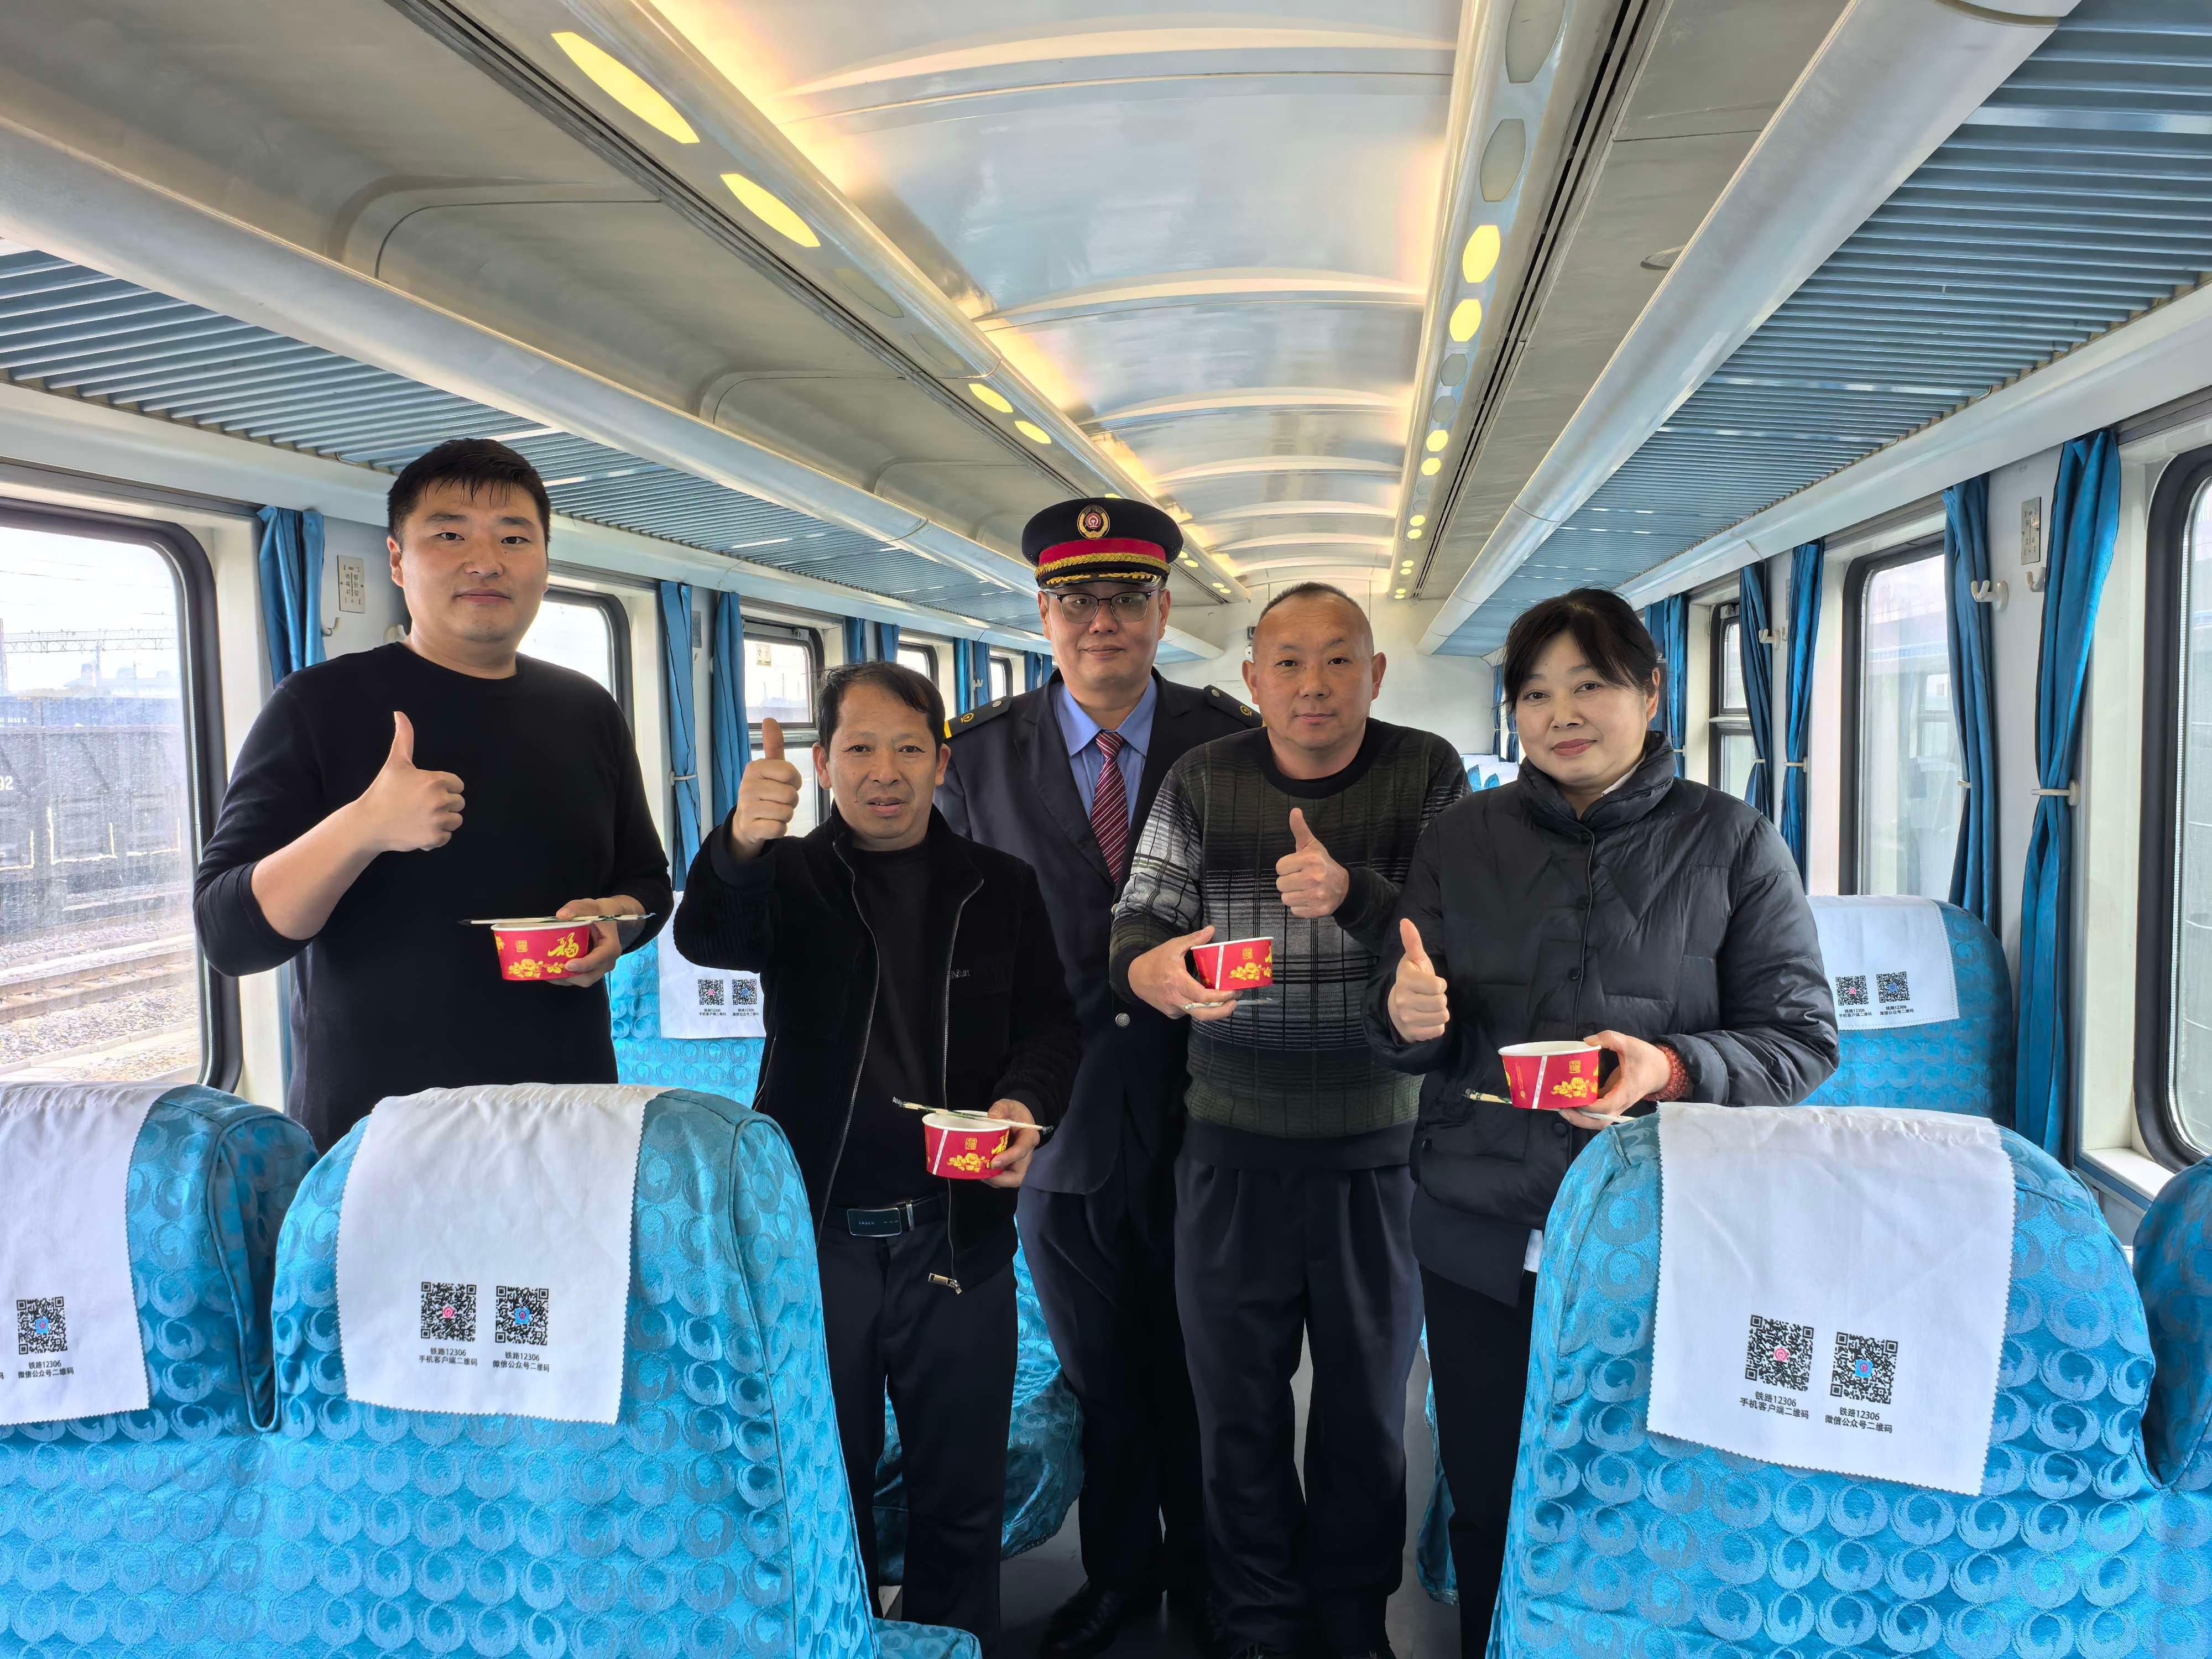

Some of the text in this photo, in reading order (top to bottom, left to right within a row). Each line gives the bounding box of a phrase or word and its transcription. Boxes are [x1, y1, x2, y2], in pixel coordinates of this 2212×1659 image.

[430, 1347, 467, 1357] 铁路12306
[505, 1351, 540, 1361] 铁路12306
[28, 1360, 62, 1369] 铁路12306
[419, 1354, 478, 1367] 手机客户端二维码
[492, 1359, 550, 1373] 微信公众号二维码
[18, 1366, 75, 1379] 微信公众号二维码
[1755, 1391, 1797, 1407] 铁路12306
[1740, 1397, 1809, 1420] 手机客户端二维码
[1839, 1406, 1880, 1421] 铁路12306
[1825, 1415, 1893, 1433] 微信公众号二维码
